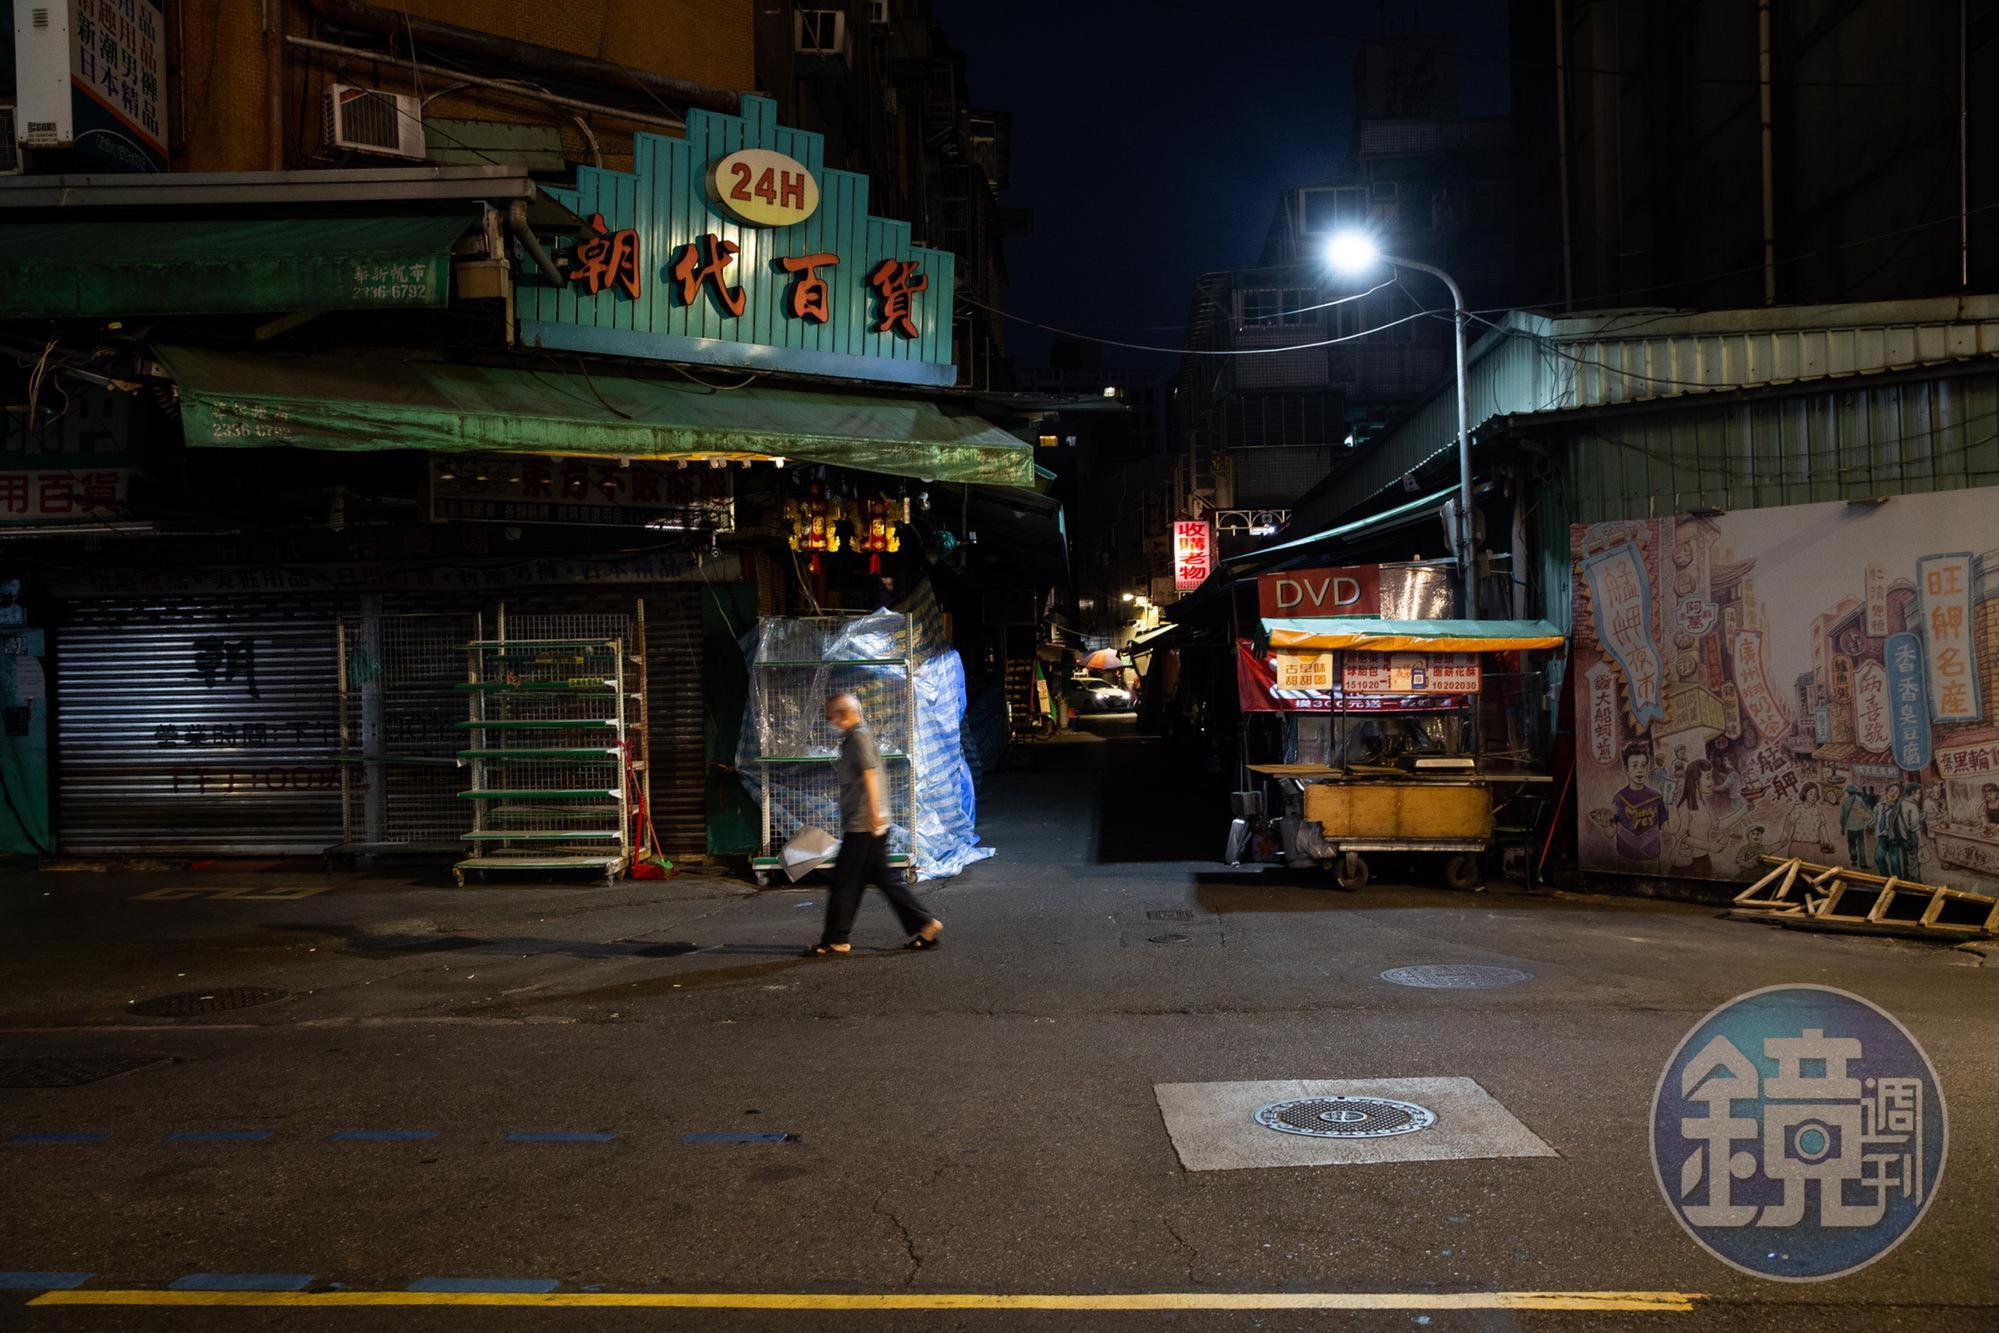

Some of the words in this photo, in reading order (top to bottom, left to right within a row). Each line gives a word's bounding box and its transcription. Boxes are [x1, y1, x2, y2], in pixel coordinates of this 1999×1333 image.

[730, 162, 805, 211] 24H
[570, 213, 928, 339] 朝代百貨
[1179, 523, 1206, 579] 收購老物
[1276, 577, 1362, 609] DVD
[1604, 561, 1654, 699] 艋舺夜市
[1927, 565, 1968, 715] 旺舺名產
[186, 635, 261, 700] 朝
[1285, 664, 1326, 674] 古早味
[1285, 674, 1327, 685] 甜甜圈
[1895, 645, 1922, 765] 香香臭豆腐
[1954, 748, 1990, 773] 黑輪
